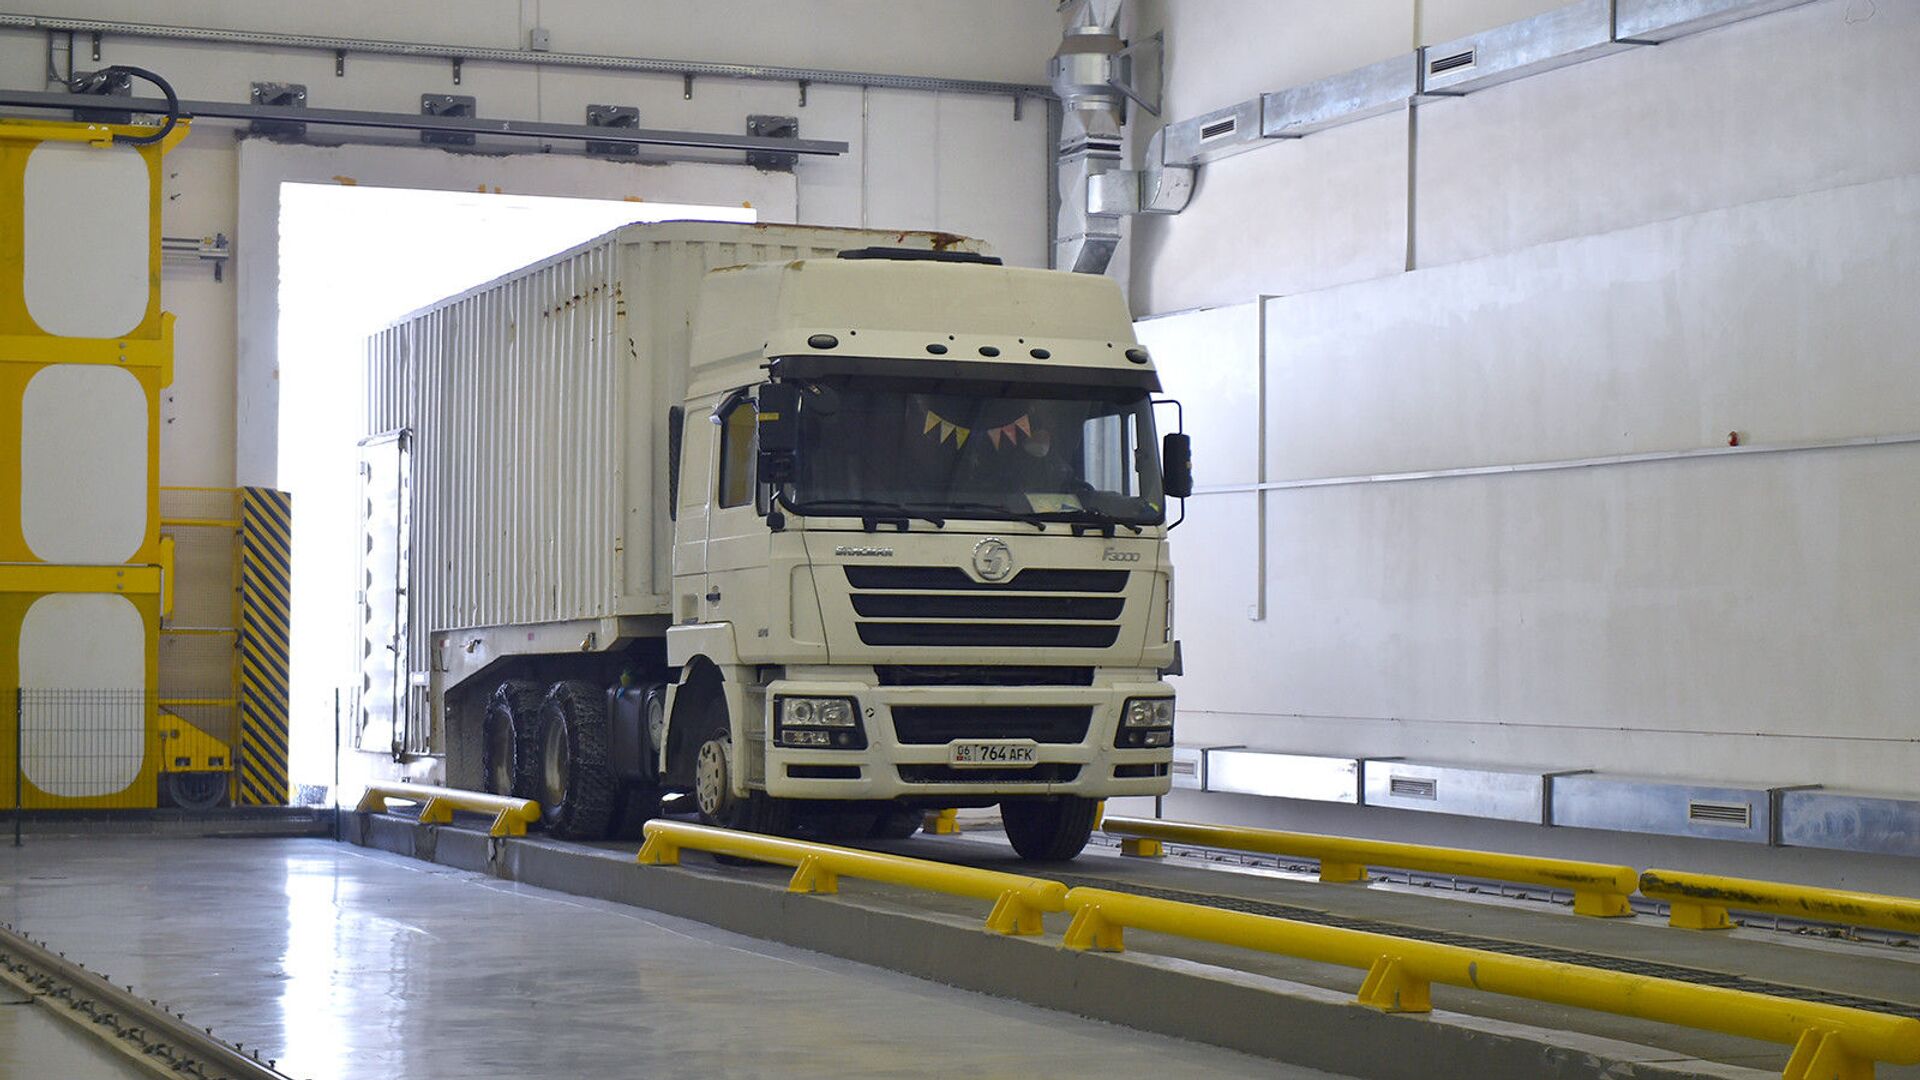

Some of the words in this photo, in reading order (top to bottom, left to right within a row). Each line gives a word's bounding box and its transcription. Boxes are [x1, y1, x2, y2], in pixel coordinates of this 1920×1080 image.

[1102, 547, 1141, 561] F3000
[957, 745, 970, 755] 06
[980, 746, 1006, 760] 764
[1010, 748, 1032, 760] AFK
